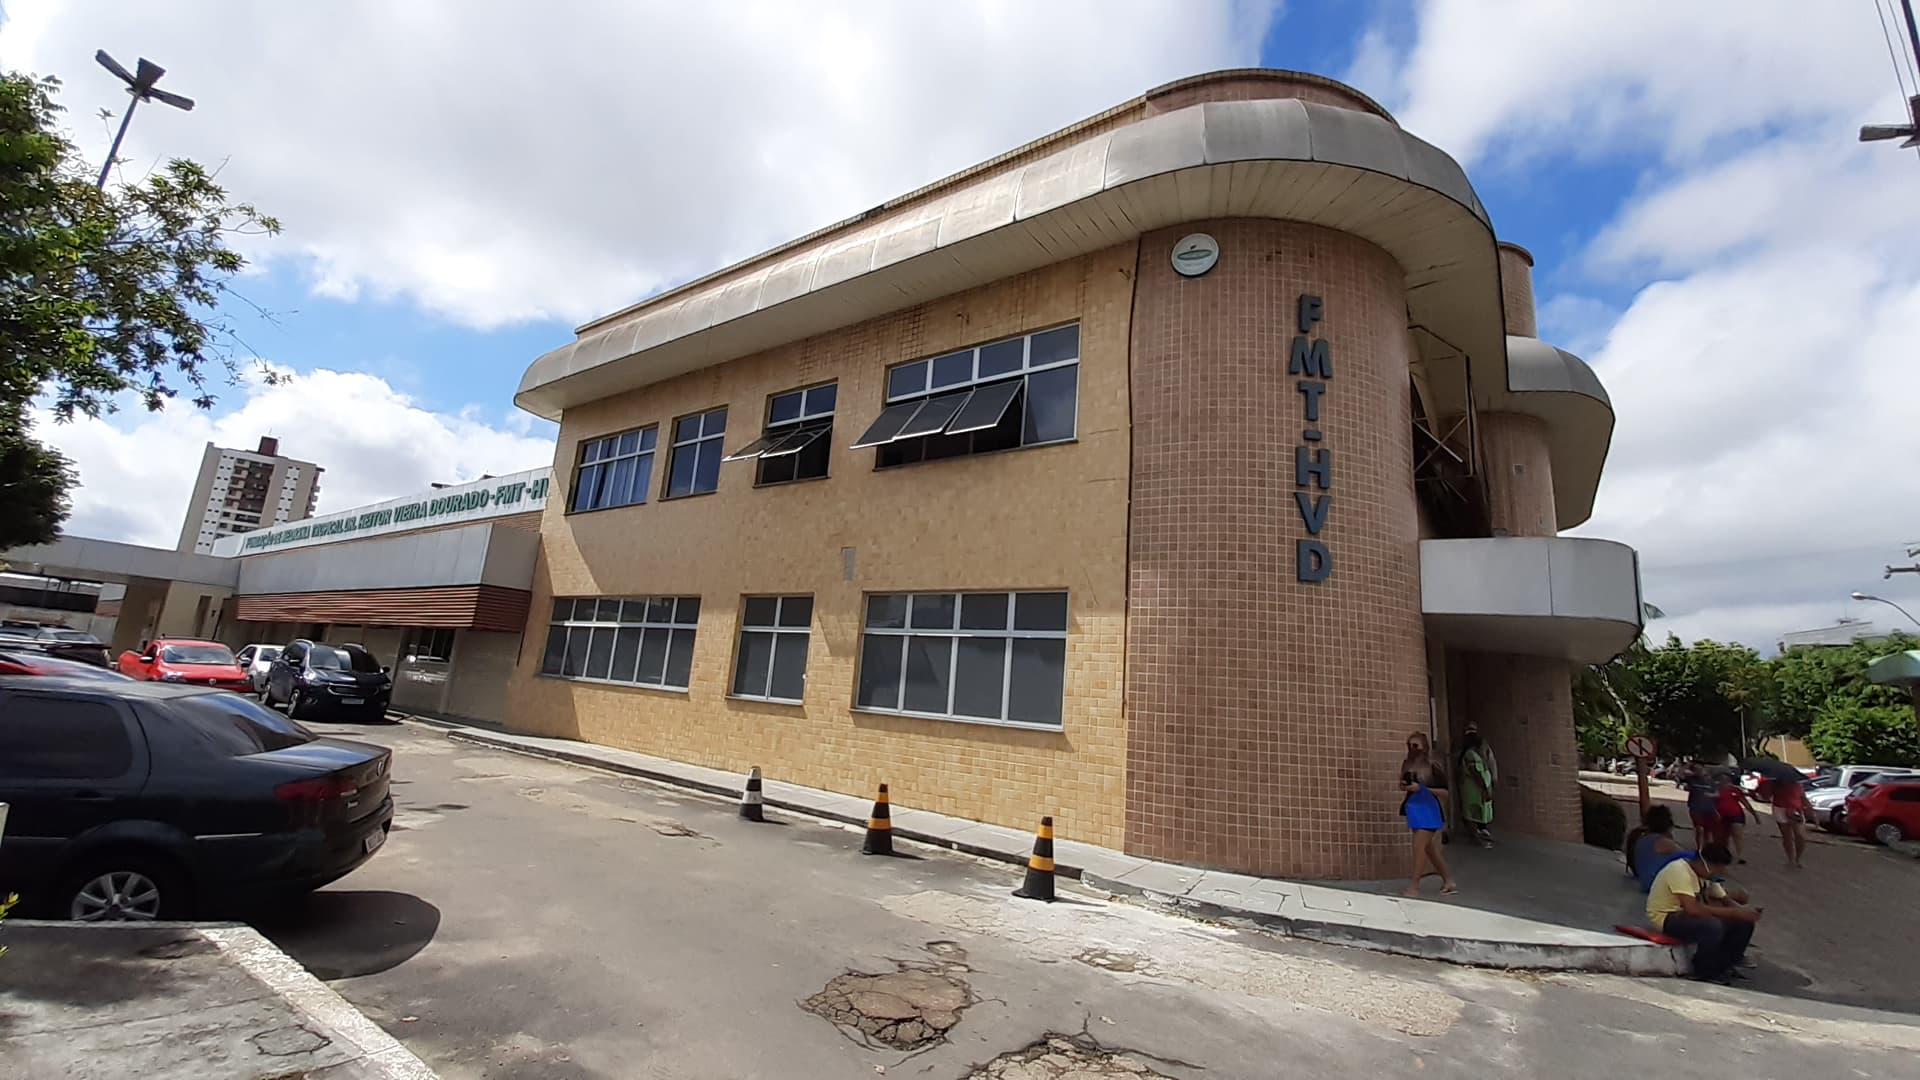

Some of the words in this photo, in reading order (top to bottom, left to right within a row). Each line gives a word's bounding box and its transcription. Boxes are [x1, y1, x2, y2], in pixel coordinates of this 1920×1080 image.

[358, 508, 393, 530] HEITOR
[394, 501, 428, 523] VIEIRA
[1289, 294, 1332, 583] FMT-HVD
